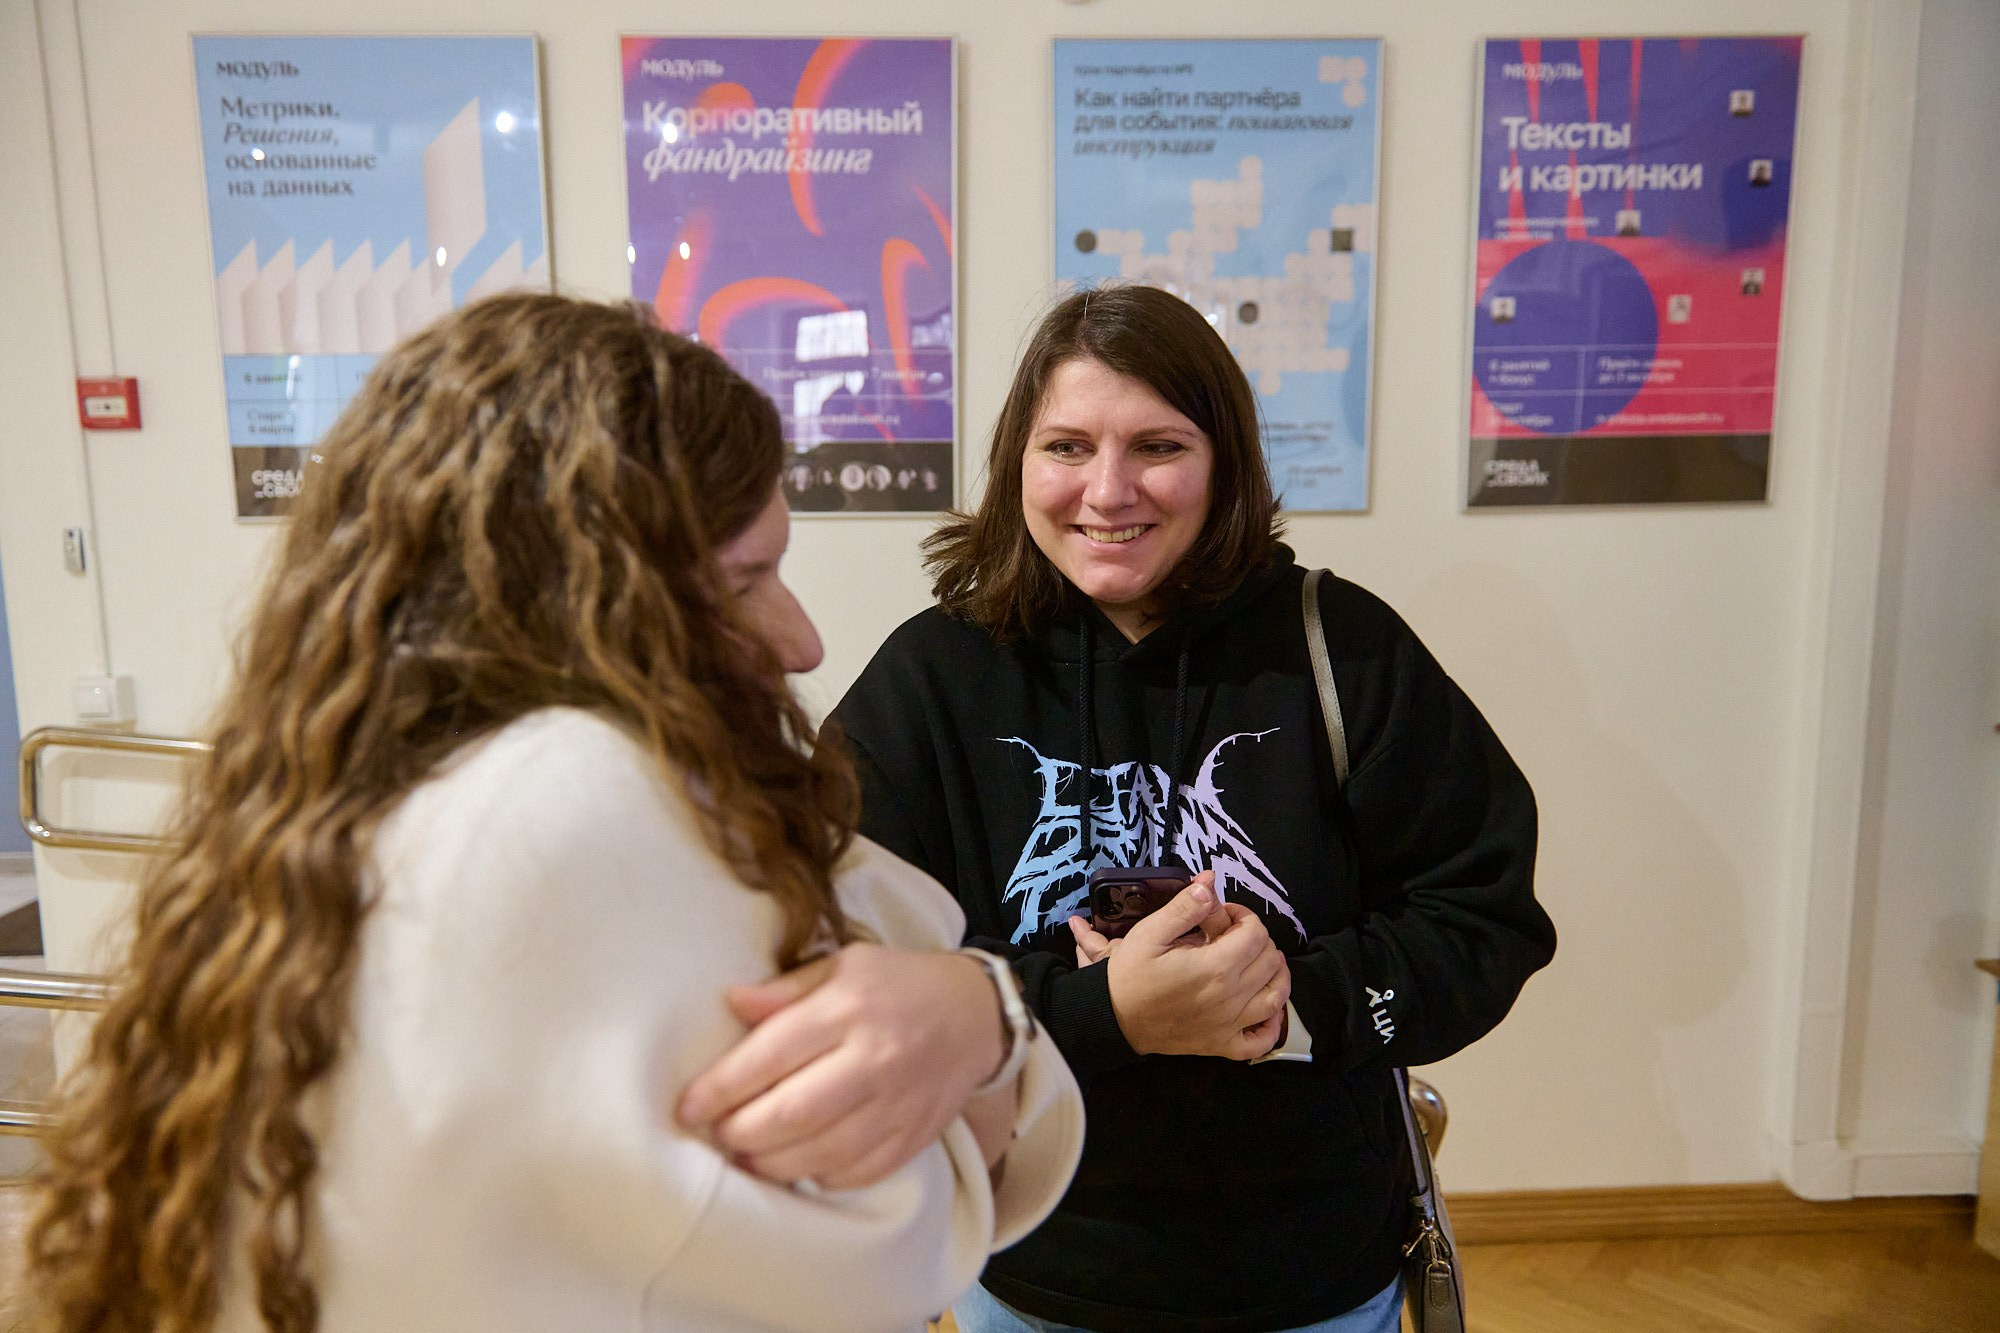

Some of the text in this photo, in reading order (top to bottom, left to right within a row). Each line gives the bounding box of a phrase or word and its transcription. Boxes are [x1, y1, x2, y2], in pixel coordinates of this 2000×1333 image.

[216, 60, 299, 82] модуль
[641, 57, 723, 81] модуль
[1502, 62, 1583, 85] модуль
[1073, 87, 1301, 113] Как найти партнёра
[642, 100, 923, 138] Корпоративный
[1501, 116, 1631, 151] Тексты
[226, 153, 377, 171] основанные
[642, 136, 873, 182] фандрайзинг
[228, 179, 354, 199] на данных
[1500, 163, 1703, 204] и картинки
